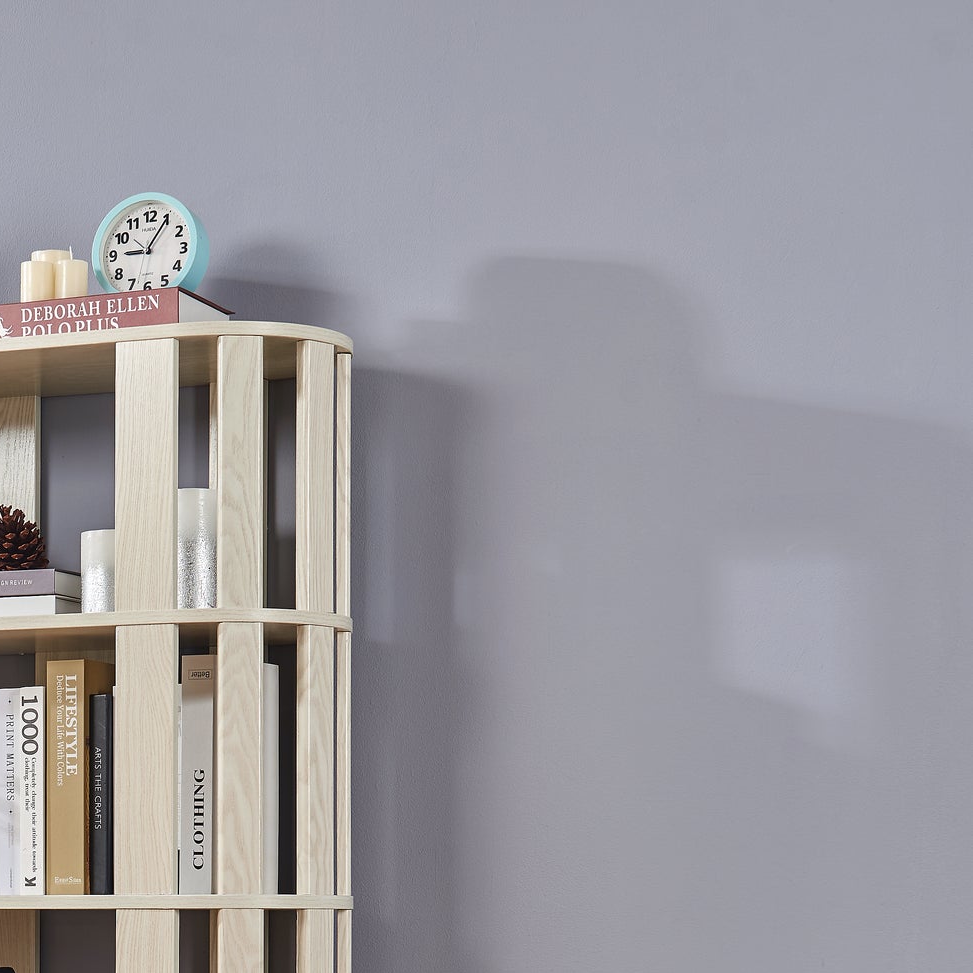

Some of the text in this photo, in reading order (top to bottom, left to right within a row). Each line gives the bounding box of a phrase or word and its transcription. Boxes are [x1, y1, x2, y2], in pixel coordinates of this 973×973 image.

[143, 210, 157, 223] 12
[163, 213, 169, 225] 1
[126, 217, 139, 230] 11
[175, 225, 183, 237] 2
[114, 232, 129, 244] 10
[179, 242, 188, 254] 3
[109, 250, 117, 262] 9
[172, 260, 182, 271] 4
[114, 268, 123, 280] 8
[127, 278, 136, 290] 7
[143, 281, 152, 290] 6
[160, 275, 169, 287] 5
[21, 294, 160, 323] DEBORAH ELLEN
[56, 675, 64, 703] Deduce
[56, 705, 64, 723] Your
[21, 695, 39, 756] 1000
[65, 674, 78, 776] LIFESTYLE
[56, 725, 64, 740] Life
[6, 714, 15, 801] PRINT MATTERS
[94, 747, 102, 830] ARTS THE CRAFTS
[192, 769, 205, 870] CLOTHING
